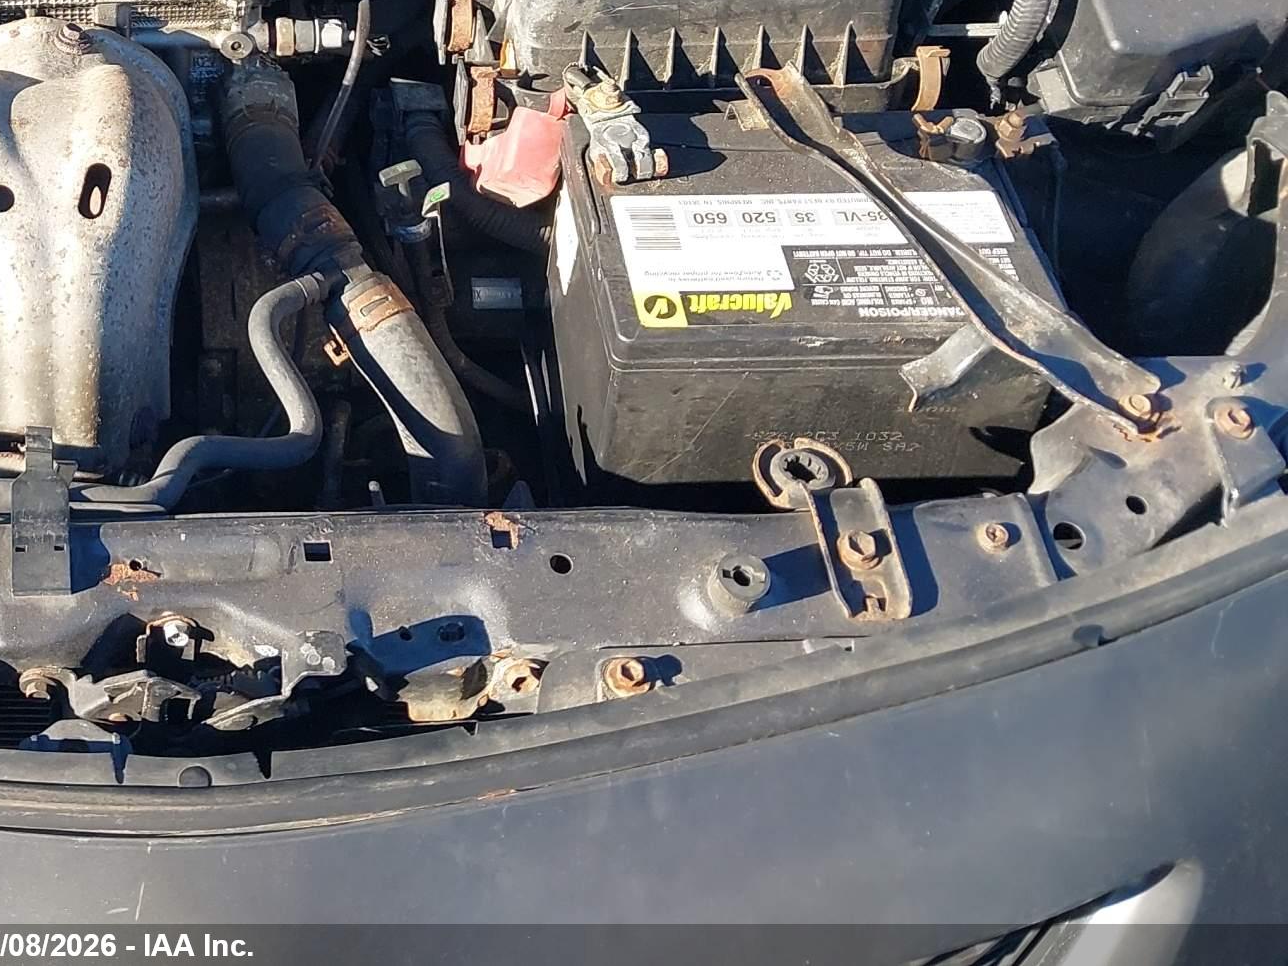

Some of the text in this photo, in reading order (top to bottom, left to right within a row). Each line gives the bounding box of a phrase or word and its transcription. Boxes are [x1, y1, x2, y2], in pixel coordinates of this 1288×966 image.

[693, 210, 888, 225] 35-VL 35 520 650
[686, 292, 792, 319] Valucraft
